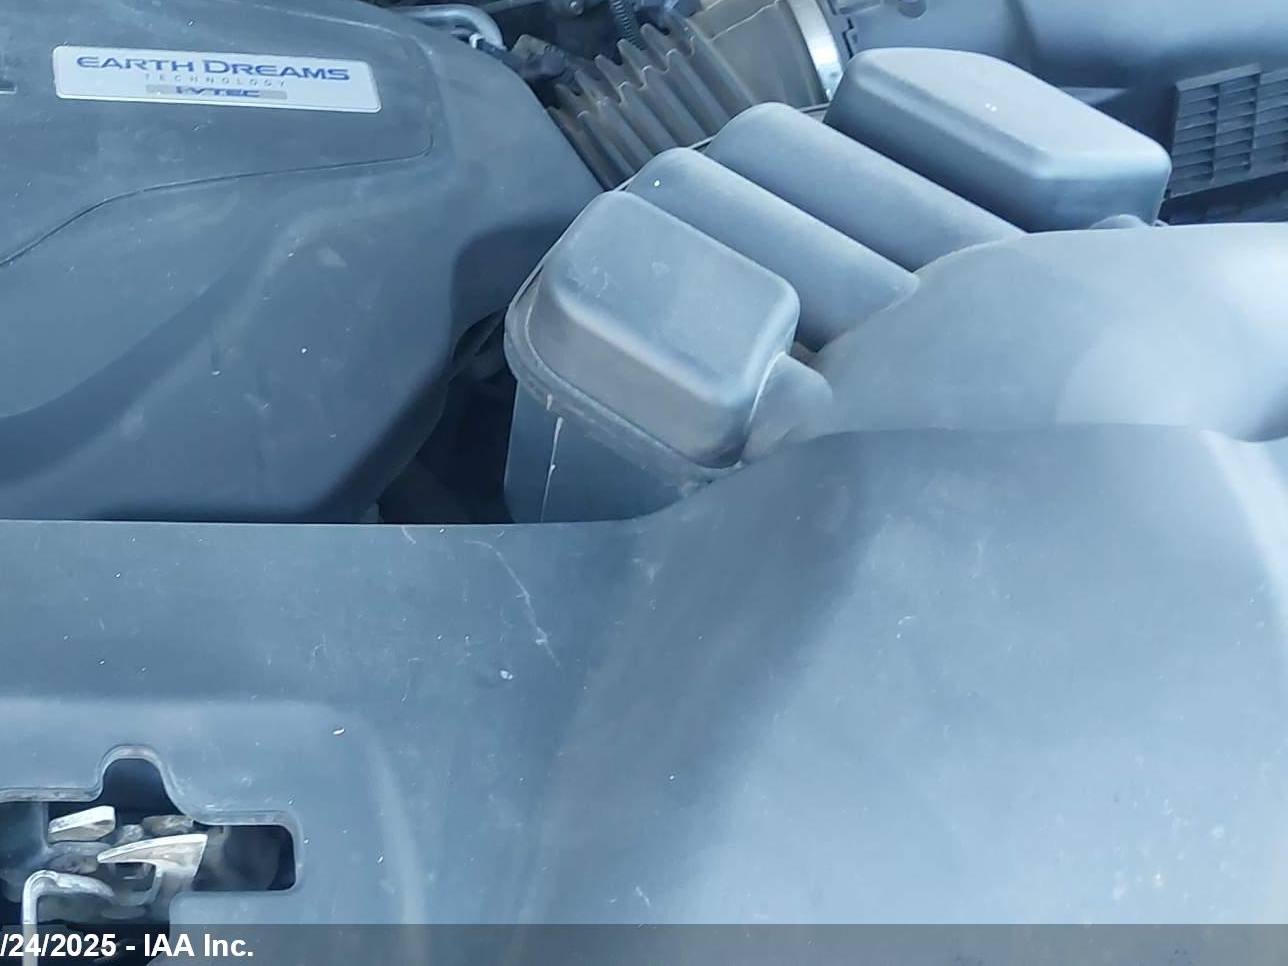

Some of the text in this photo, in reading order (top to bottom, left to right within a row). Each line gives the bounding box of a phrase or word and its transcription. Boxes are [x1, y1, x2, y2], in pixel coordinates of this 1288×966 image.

[76, 55, 350, 81] EARTH DREAMS
[144, 73, 287, 88] TECHNOLOGY
